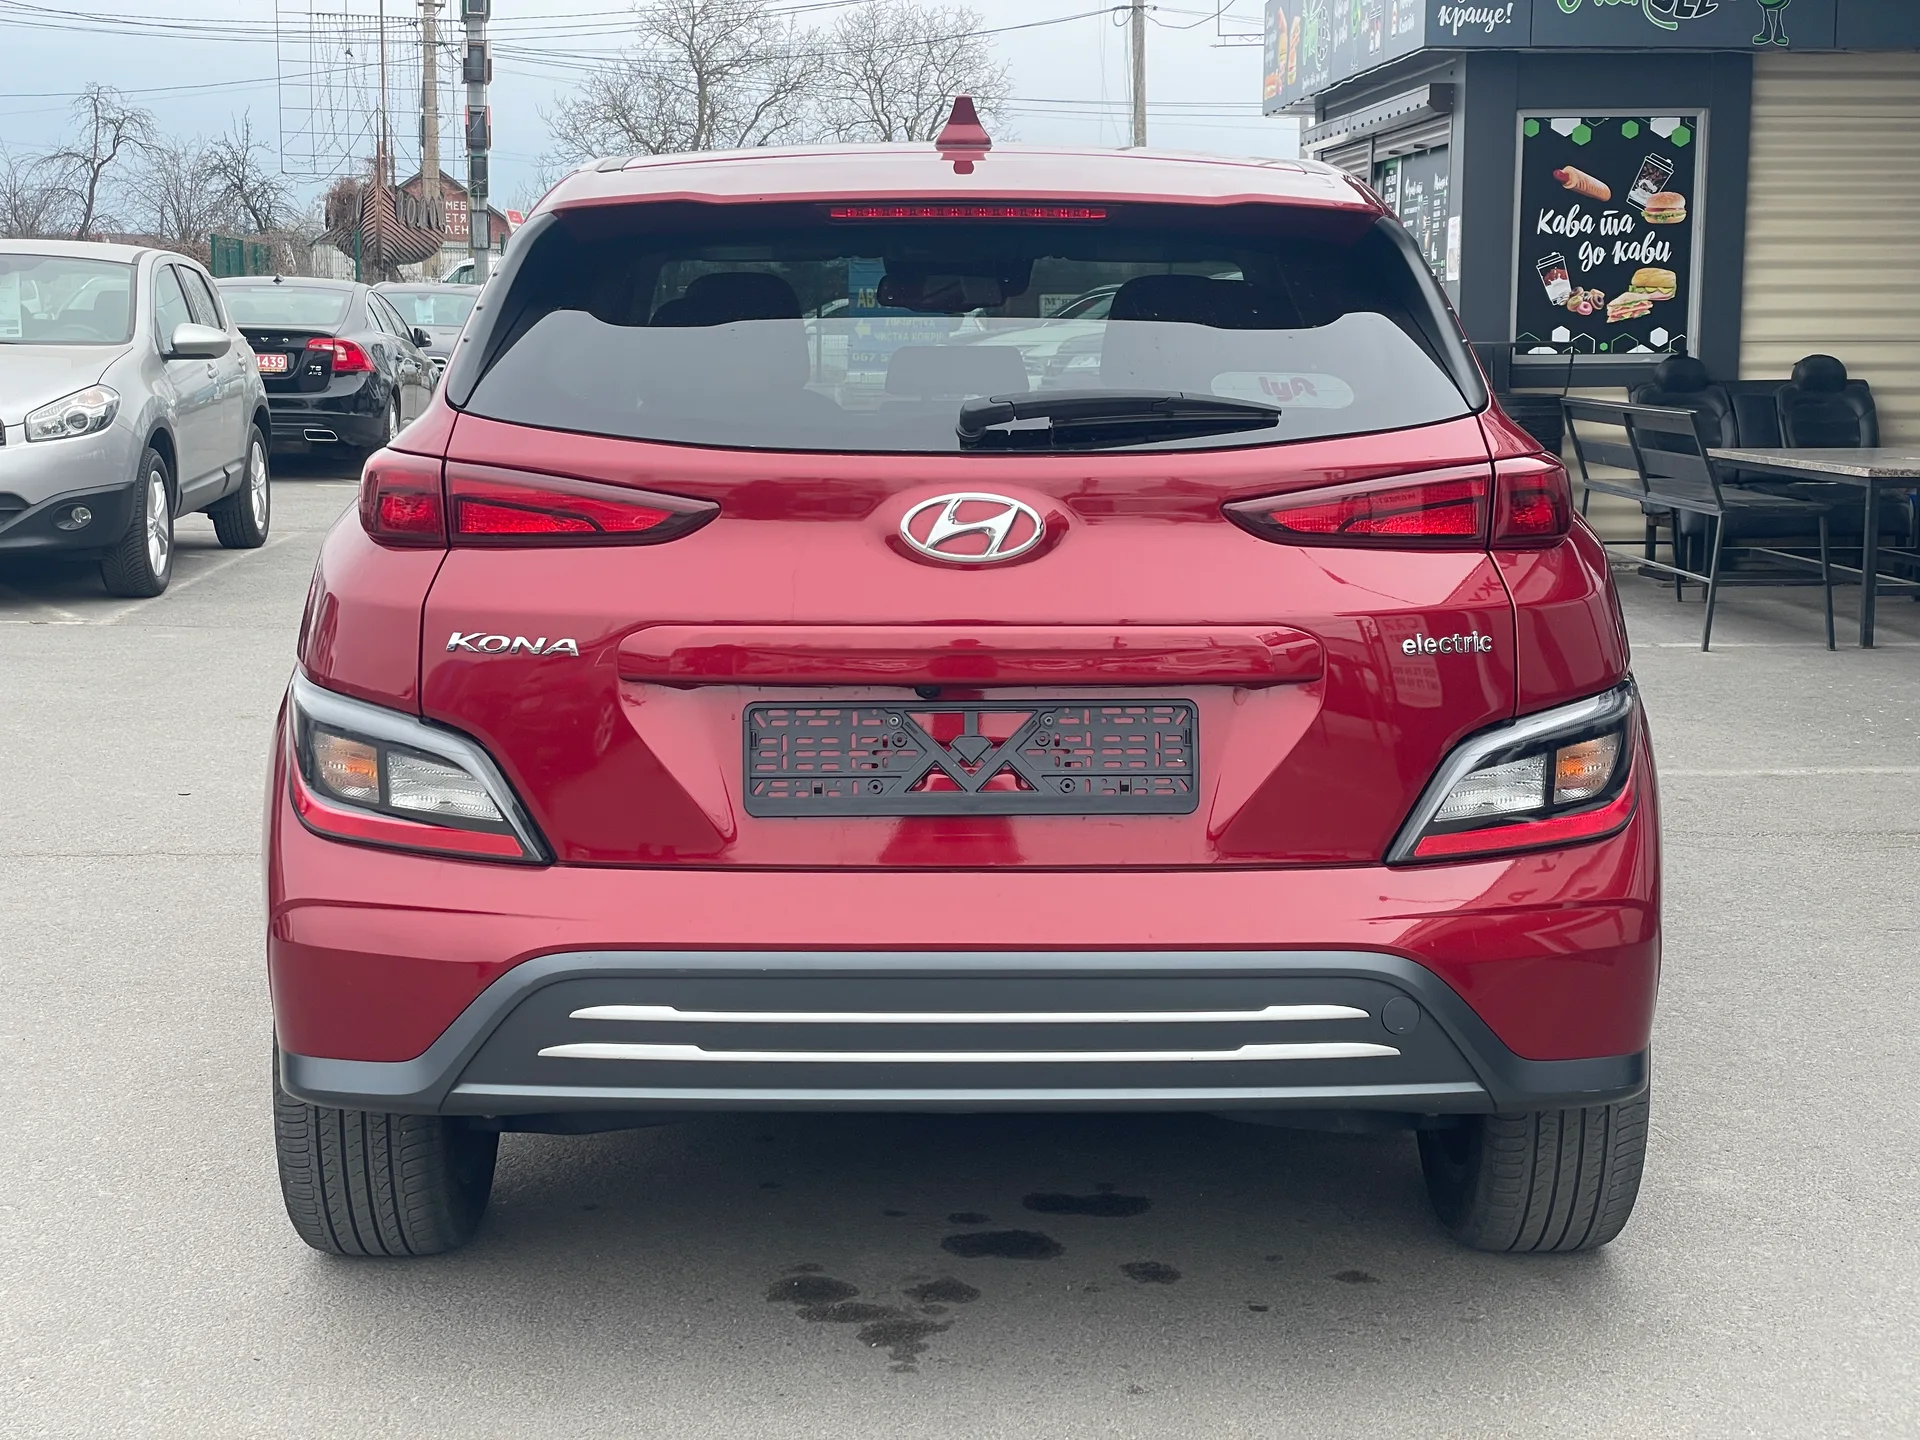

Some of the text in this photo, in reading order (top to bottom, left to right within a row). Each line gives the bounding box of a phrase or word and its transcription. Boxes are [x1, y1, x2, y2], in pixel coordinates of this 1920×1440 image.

[1438, 2, 1513, 36] краще!
[1537, 204, 1596, 237] Кава
[1578, 230, 1672, 272] до кави
[446, 631, 579, 657] KONA
[1402, 631, 1492, 655] electric
